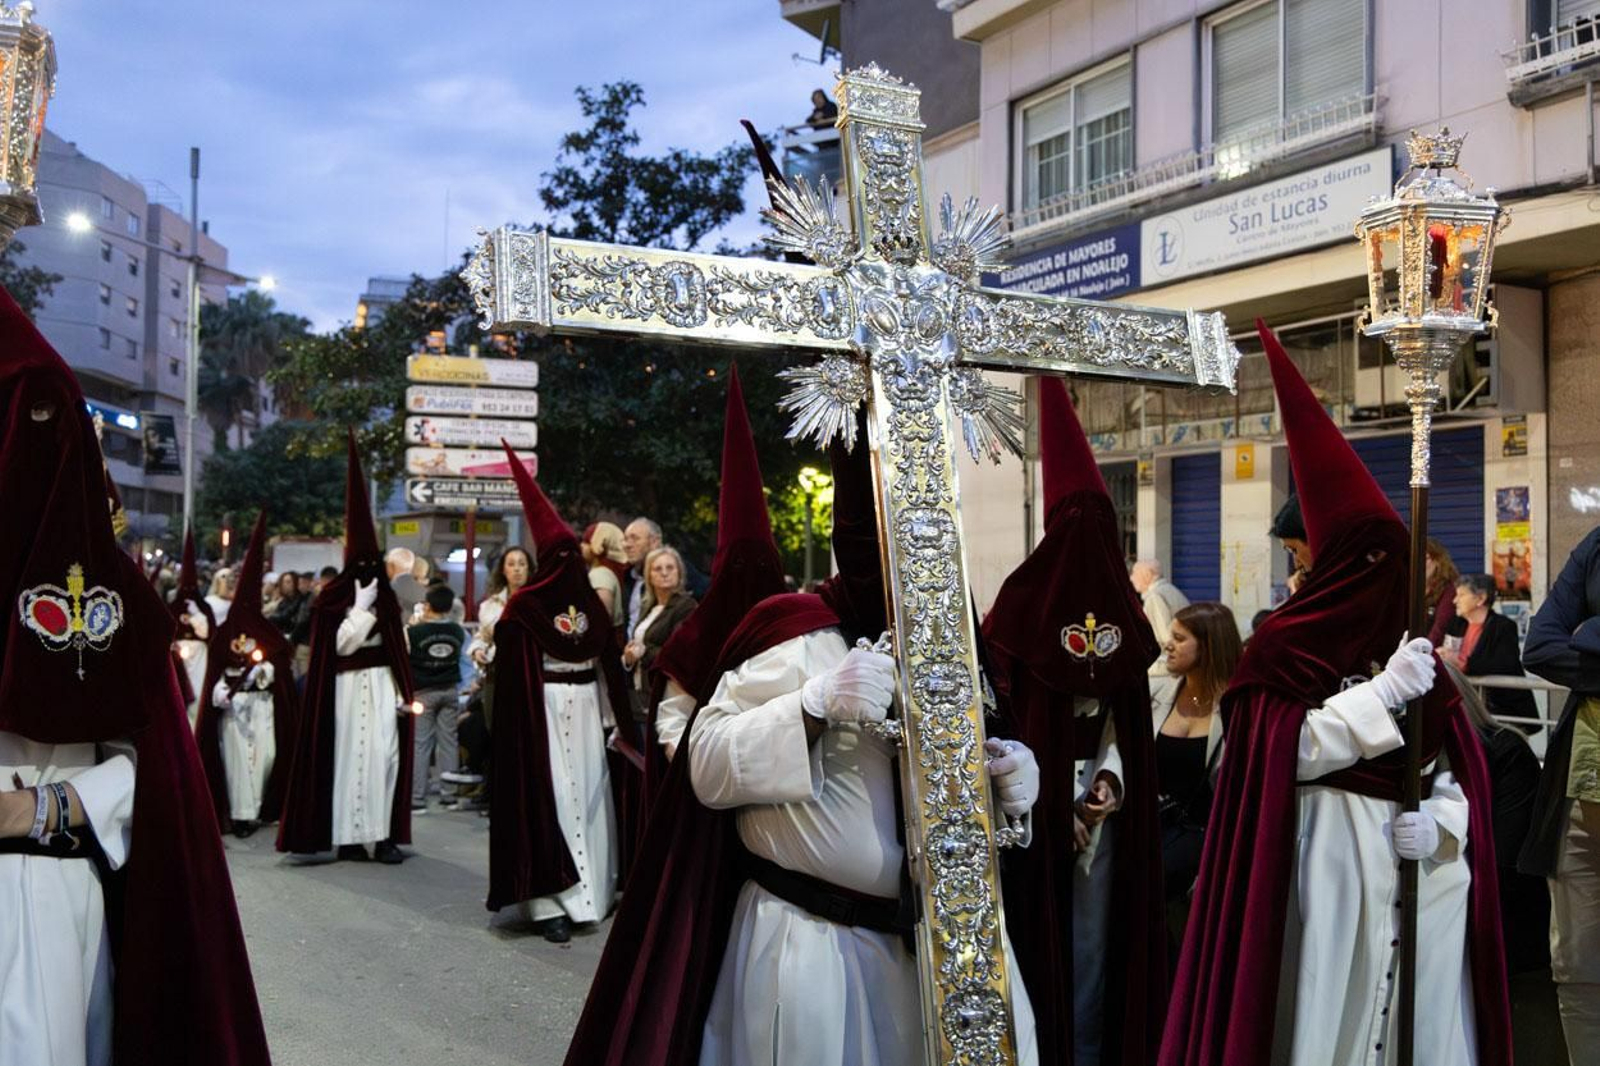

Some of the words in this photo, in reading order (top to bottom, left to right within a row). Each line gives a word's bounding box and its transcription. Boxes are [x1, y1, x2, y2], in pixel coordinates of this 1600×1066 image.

[1193, 199, 1238, 222] Unidad
[1242, 195, 1258, 208] de
[1262, 178, 1318, 202] estancia
[1323, 162, 1371, 185] diurna
[1229, 212, 1262, 235] San
[1271, 193, 1328, 223] Lucas
[1001, 257, 1053, 284] RESIDENCIA
[1054, 252, 1067, 268] DE
[1068, 237, 1117, 264] MAYORES
[1066, 267, 1081, 284] EN
[1082, 253, 1129, 279] NOALEJO
[461, 482, 484, 492] BAR
